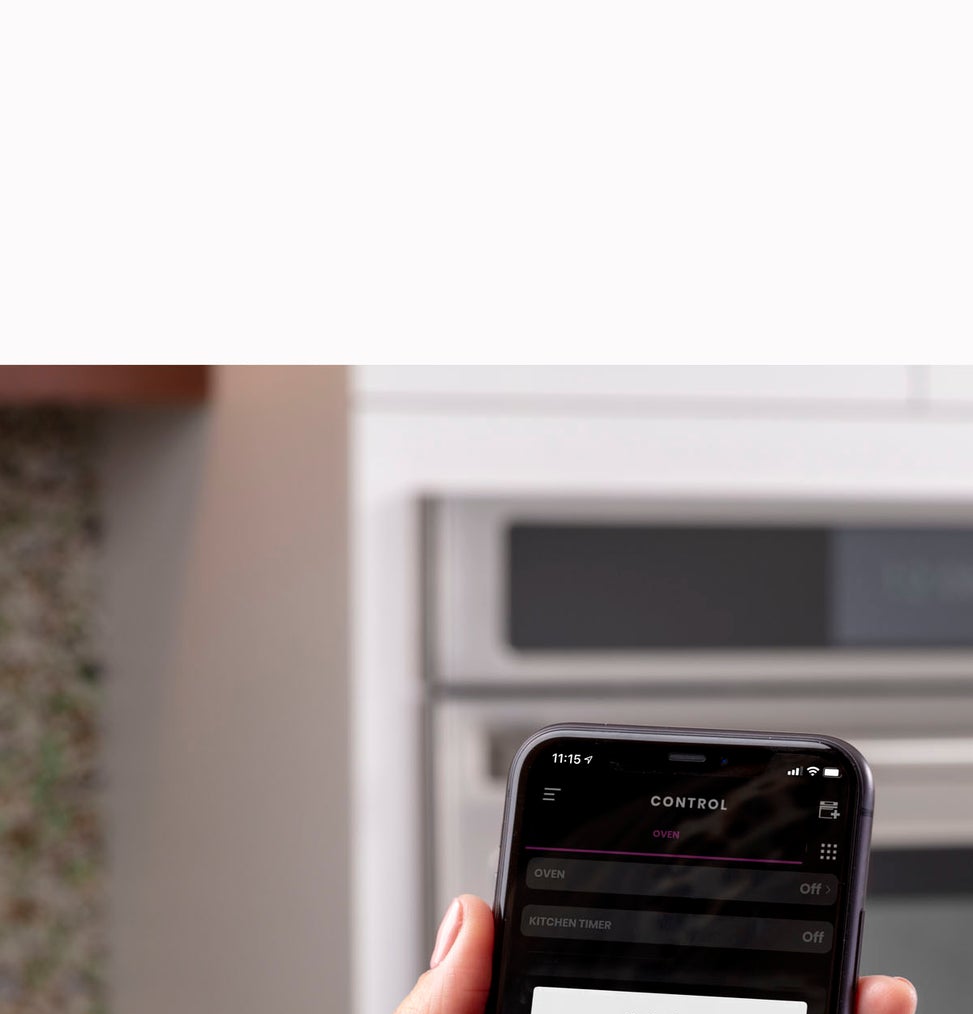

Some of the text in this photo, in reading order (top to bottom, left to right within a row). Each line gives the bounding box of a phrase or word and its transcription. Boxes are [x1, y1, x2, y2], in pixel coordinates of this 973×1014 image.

[551, 753, 581, 765] 11:15
[650, 795, 728, 811] CONTROL
[652, 829, 680, 840] OVEN
[534, 868, 565, 880] OVEN
[799, 882, 822, 895] Off
[528, 916, 612, 931] KITCHEN TIMER
[802, 930, 824, 944] Off
